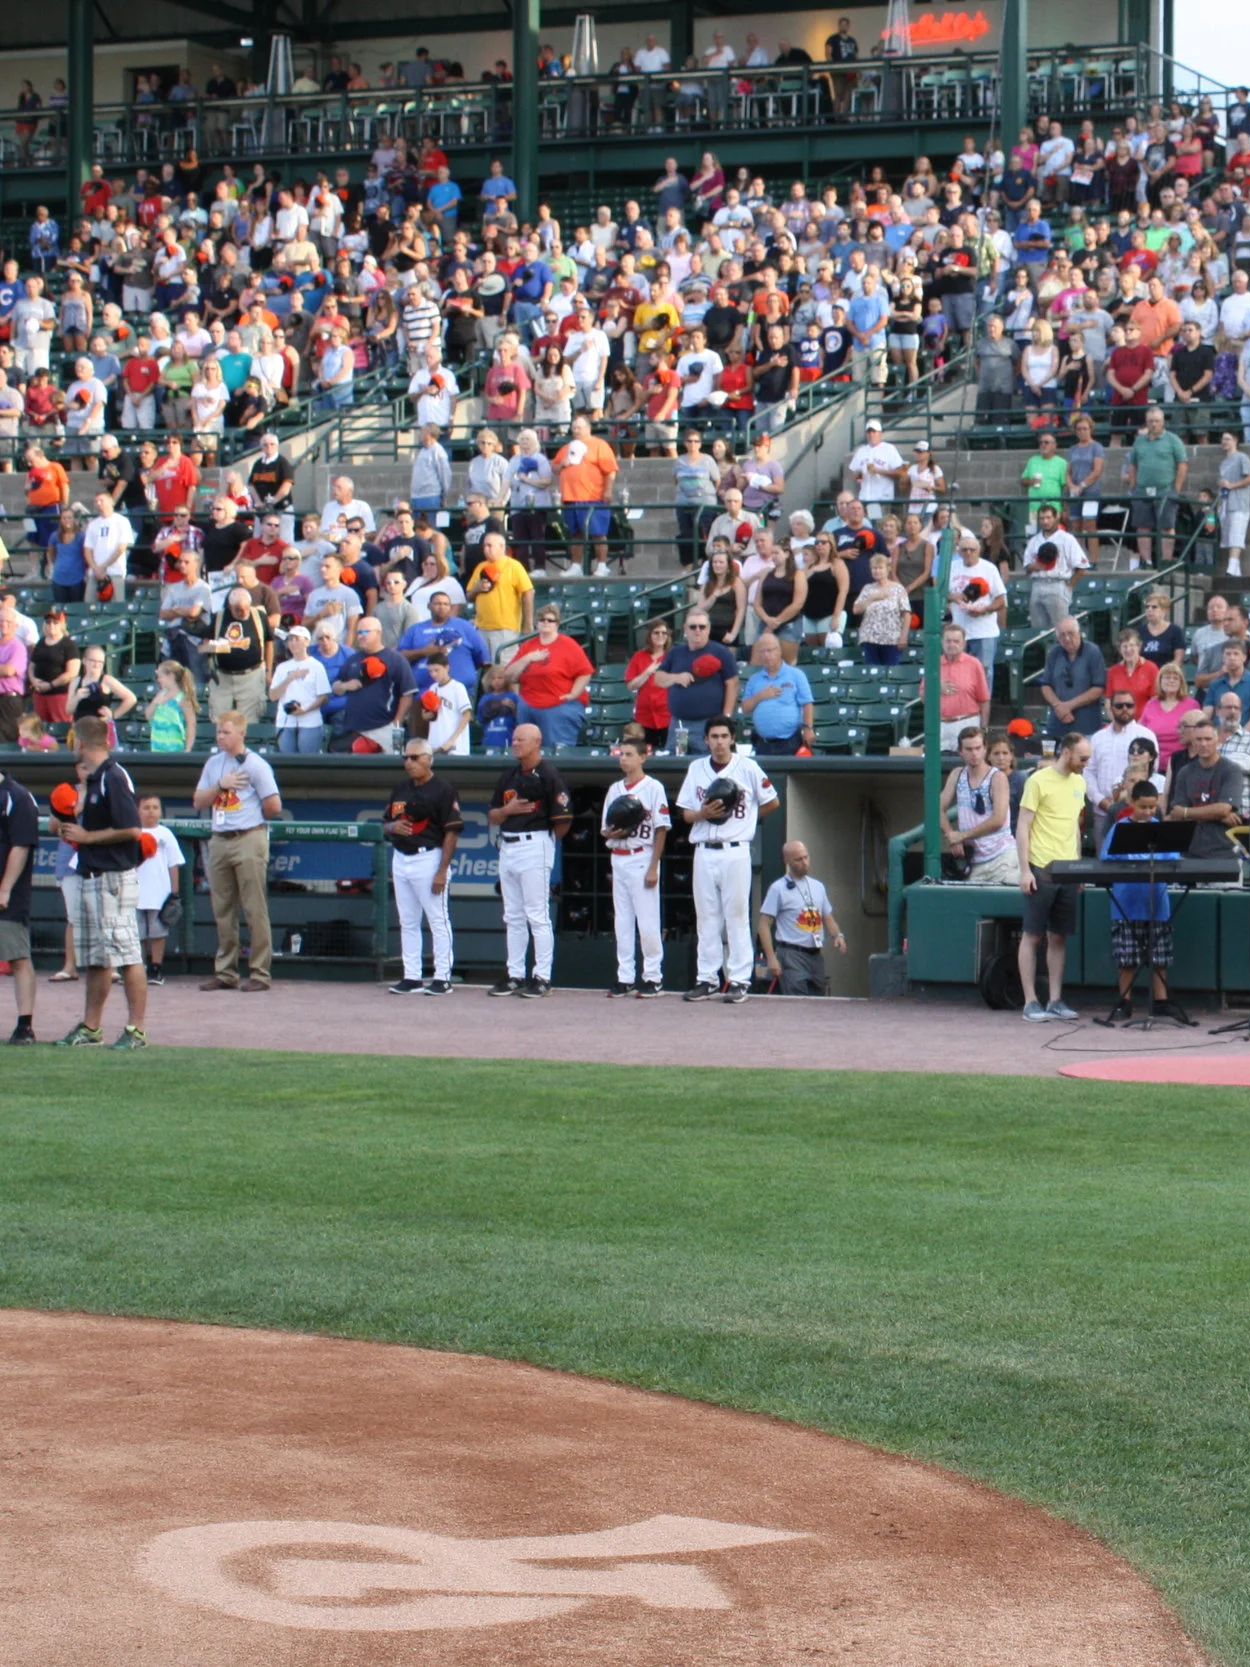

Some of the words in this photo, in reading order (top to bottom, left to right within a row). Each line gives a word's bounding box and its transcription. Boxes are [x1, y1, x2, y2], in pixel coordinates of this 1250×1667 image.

[285, 826, 295, 834] FLY
[311, 827, 325, 835] OWN
[325, 827, 339, 835] FLAG
